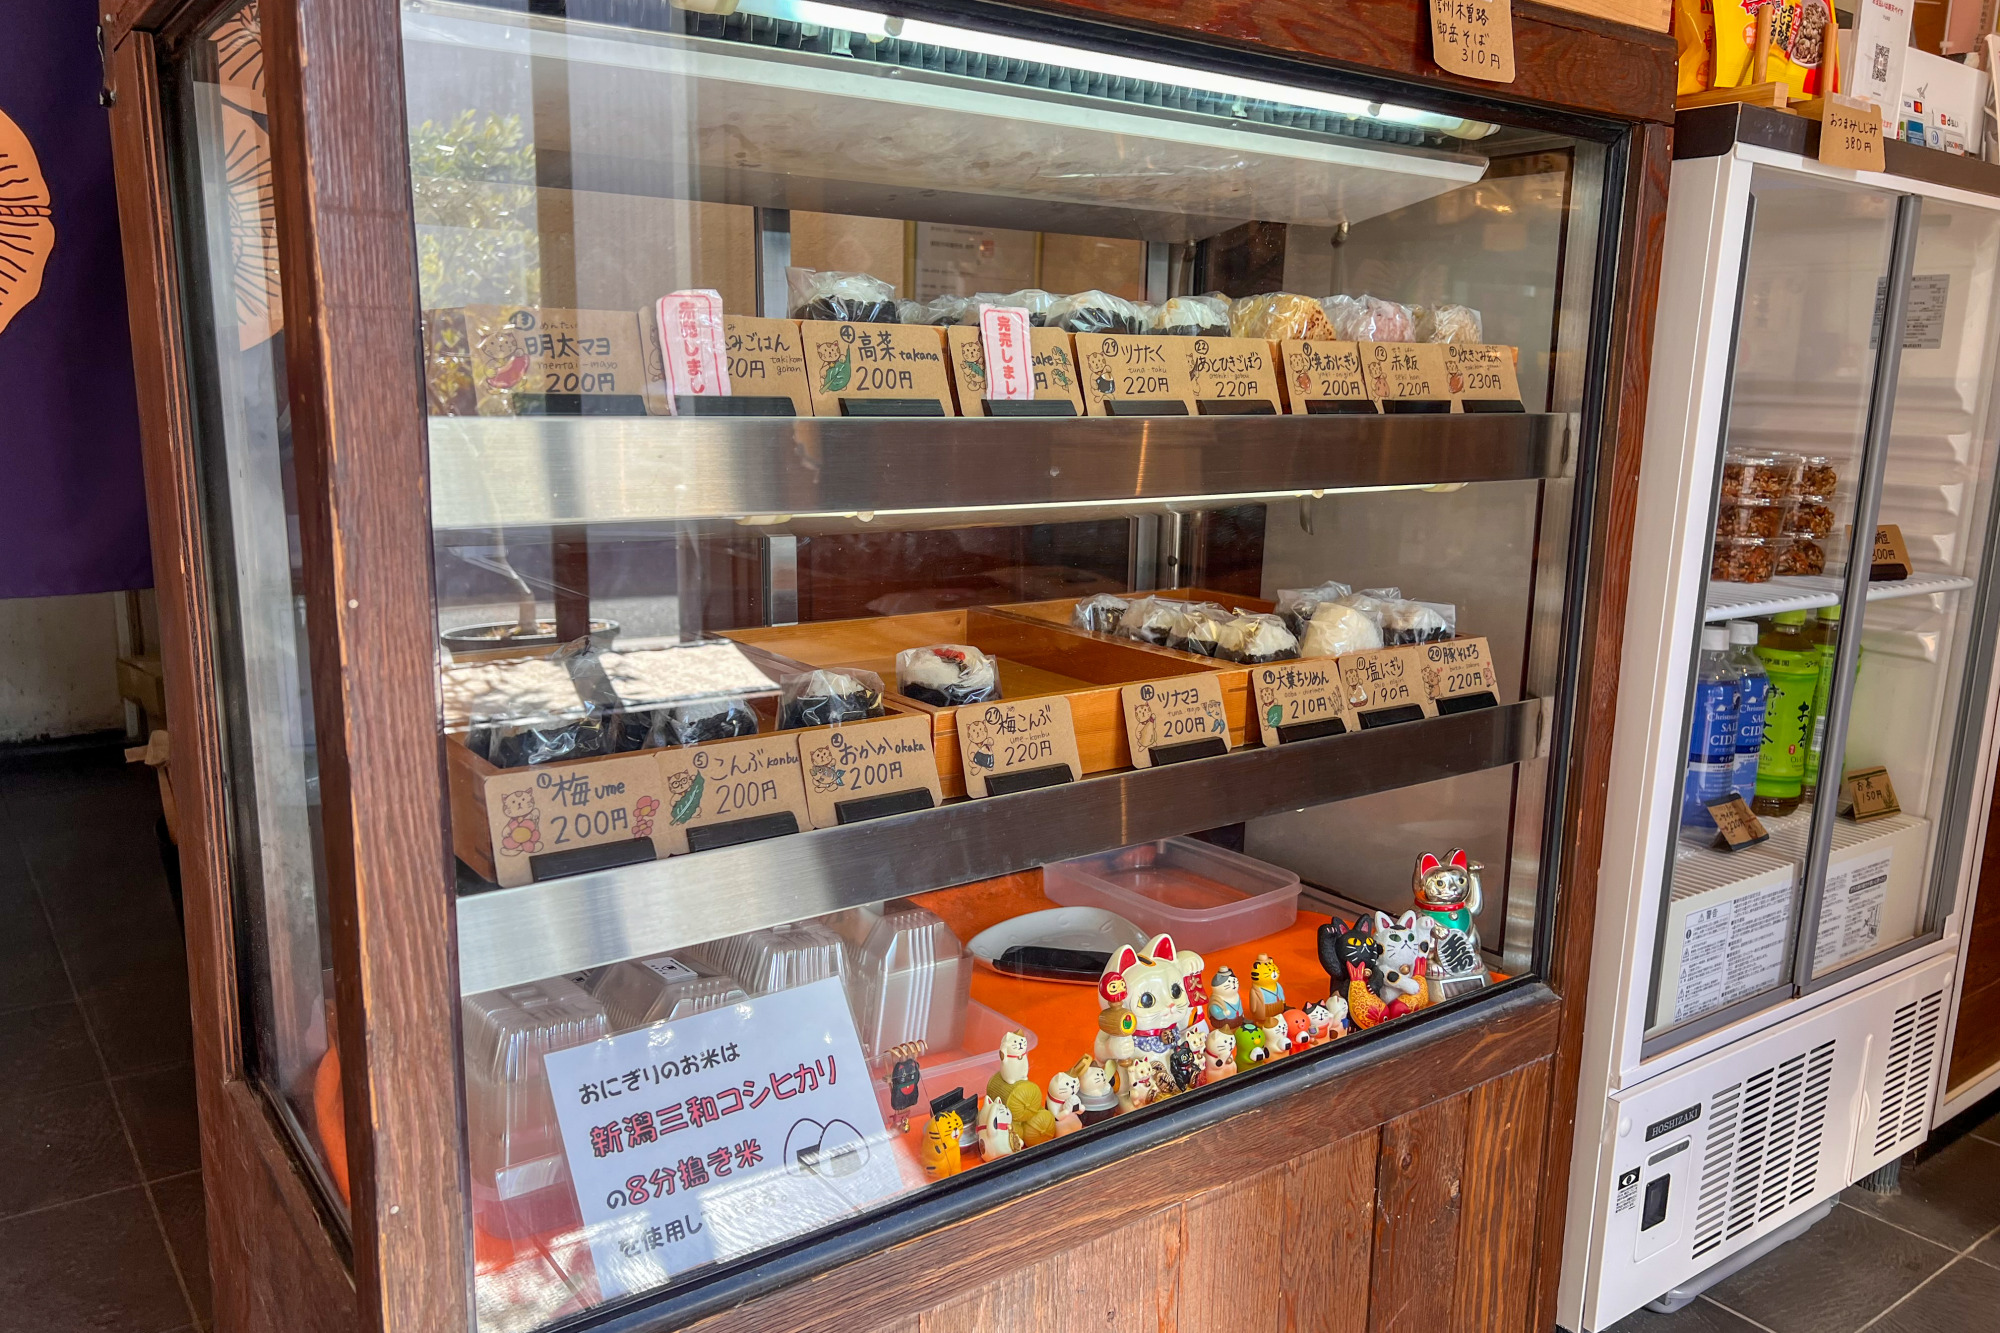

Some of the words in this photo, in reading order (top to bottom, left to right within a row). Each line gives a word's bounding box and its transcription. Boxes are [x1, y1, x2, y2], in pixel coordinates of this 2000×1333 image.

[1461, 48, 1501, 70] 310円
[1903, 100, 1912, 108] VISA
[1845, 136, 1872, 153] 380円
[524, 332, 611, 359] 明太マヨ
[858, 330, 896, 362] 高菜
[899, 348, 940, 362] takana
[1121, 343, 1166, 364] ツナたく
[997, 315, 1018, 400] 完売しまし
[1031, 352, 1054, 367] sake
[1196, 352, 1263, 373] あとひきごぼう
[1391, 354, 1419, 371] 赤飯
[546, 372, 616, 393] 200円
[856, 366, 913, 391] 200円
[1123, 376, 1170, 394] 220円
[1215, 381, 1258, 397] 220円
[1321, 380, 1361, 396] 200円
[1397, 381, 1431, 397] 220円
[1468, 372, 1502, 390] 230円
[1443, 643, 1480, 664] 豚そぼろ
[1276, 669, 1330, 691] 大葉ちりめん
[1365, 656, 1404, 683] 塩にぎり
[1448, 672, 1482, 693] 220円
[1157, 688, 1199, 709] ツナマヨ
[1372, 684, 1409, 706] 190円
[1290, 697, 1327, 719] 210円
[996, 704, 1052, 735] 梅こんぶ
[1163, 716, 1206, 738] 200円
[839, 737, 893, 765] おかか
[895, 739, 926, 754] okaka
[1004, 740, 1052, 766] 220円
[710, 748, 764, 781] こんぶ
[767, 752, 800, 769] konbu
[849, 761, 903, 790] 200円
[551, 772, 591, 807] 梅
[595, 782, 626, 799] ume
[716, 780, 777, 814] 200円
[550, 807, 628, 844] 200円
[578, 1042, 741, 1106] おにぎりのお米は
[589, 1055, 837, 1158] 新潟三和コシヒカリ
[1651, 1107, 1699, 1138] HOSHIZAKI
